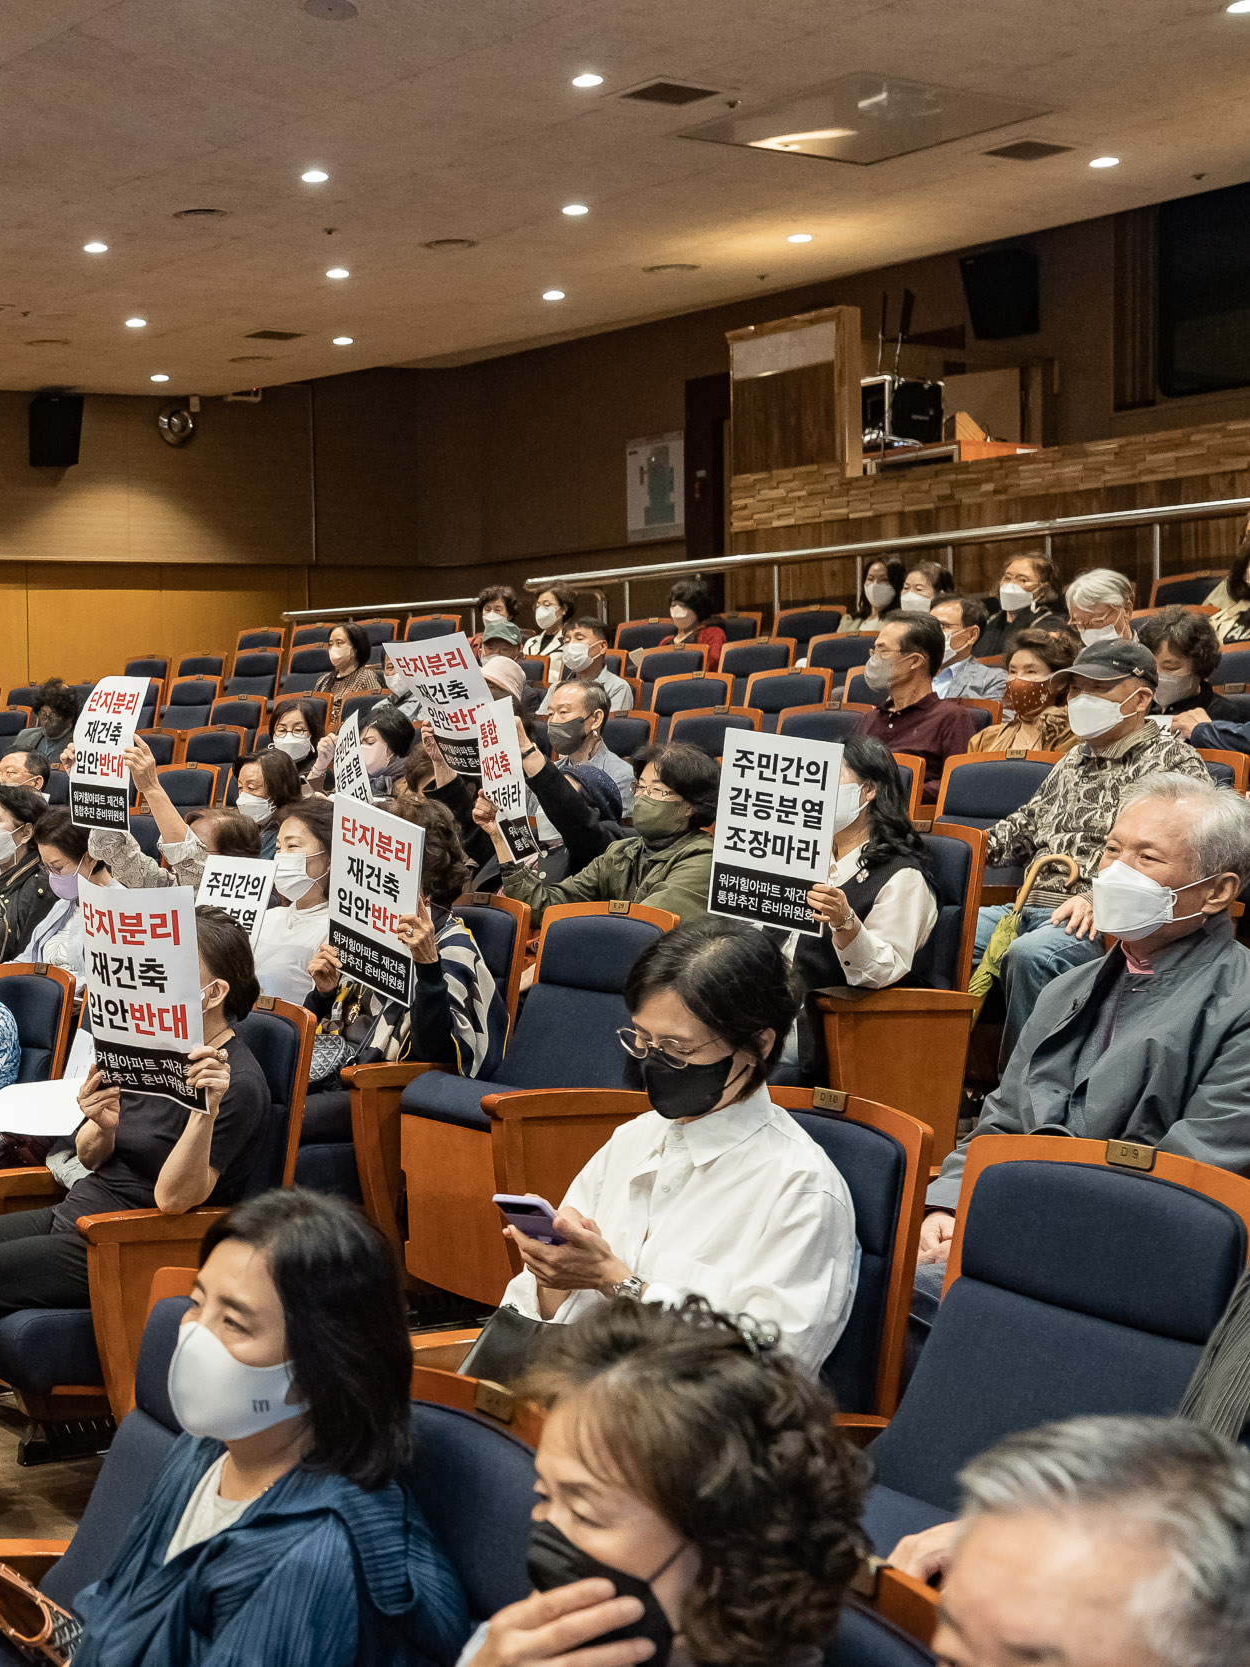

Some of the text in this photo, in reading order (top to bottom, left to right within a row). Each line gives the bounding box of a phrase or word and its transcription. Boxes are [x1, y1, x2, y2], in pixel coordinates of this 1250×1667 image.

[395, 647, 469, 678] 단지분리
[87, 689, 140, 716] 단지분리
[415, 679, 470, 705] 재건축
[84, 720, 123, 746] 재건축
[335, 726, 357, 768] 주민간의
[479, 718, 499, 749] 통합
[76, 750, 124, 779] 입안반대
[481, 750, 512, 782] 재건축
[732, 749, 829, 791] 주민간의
[73, 790, 126, 809] 워커힐아파트 재건축
[485, 780, 522, 813] 진하라
[729, 786, 824, 831] 갈등분열
[74, 804, 125, 823] 통합추진 준비위원회
[341, 814, 413, 872] 단지분리
[723, 825, 821, 870] 조장마라
[206, 871, 267, 902] 주민간의
[346, 855, 400, 903] 재건축
[718, 873, 809, 904] 워커힐아파트 재건
[717, 889, 816, 924] 통합추진 준비위원회
[82, 901, 181, 946] 단지분리
[332, 930, 407, 978] 워커힐아파트 재건축
[90, 950, 168, 994] 재건축
[364, 962, 405, 994] 준비위원회
[89, 993, 189, 1040] 입안반대
[95, 1050, 159, 1071] 커힐아파트
[99, 1069, 198, 1100] 합추진 준비위원회
[1132, 1148, 1139, 1160] 9
